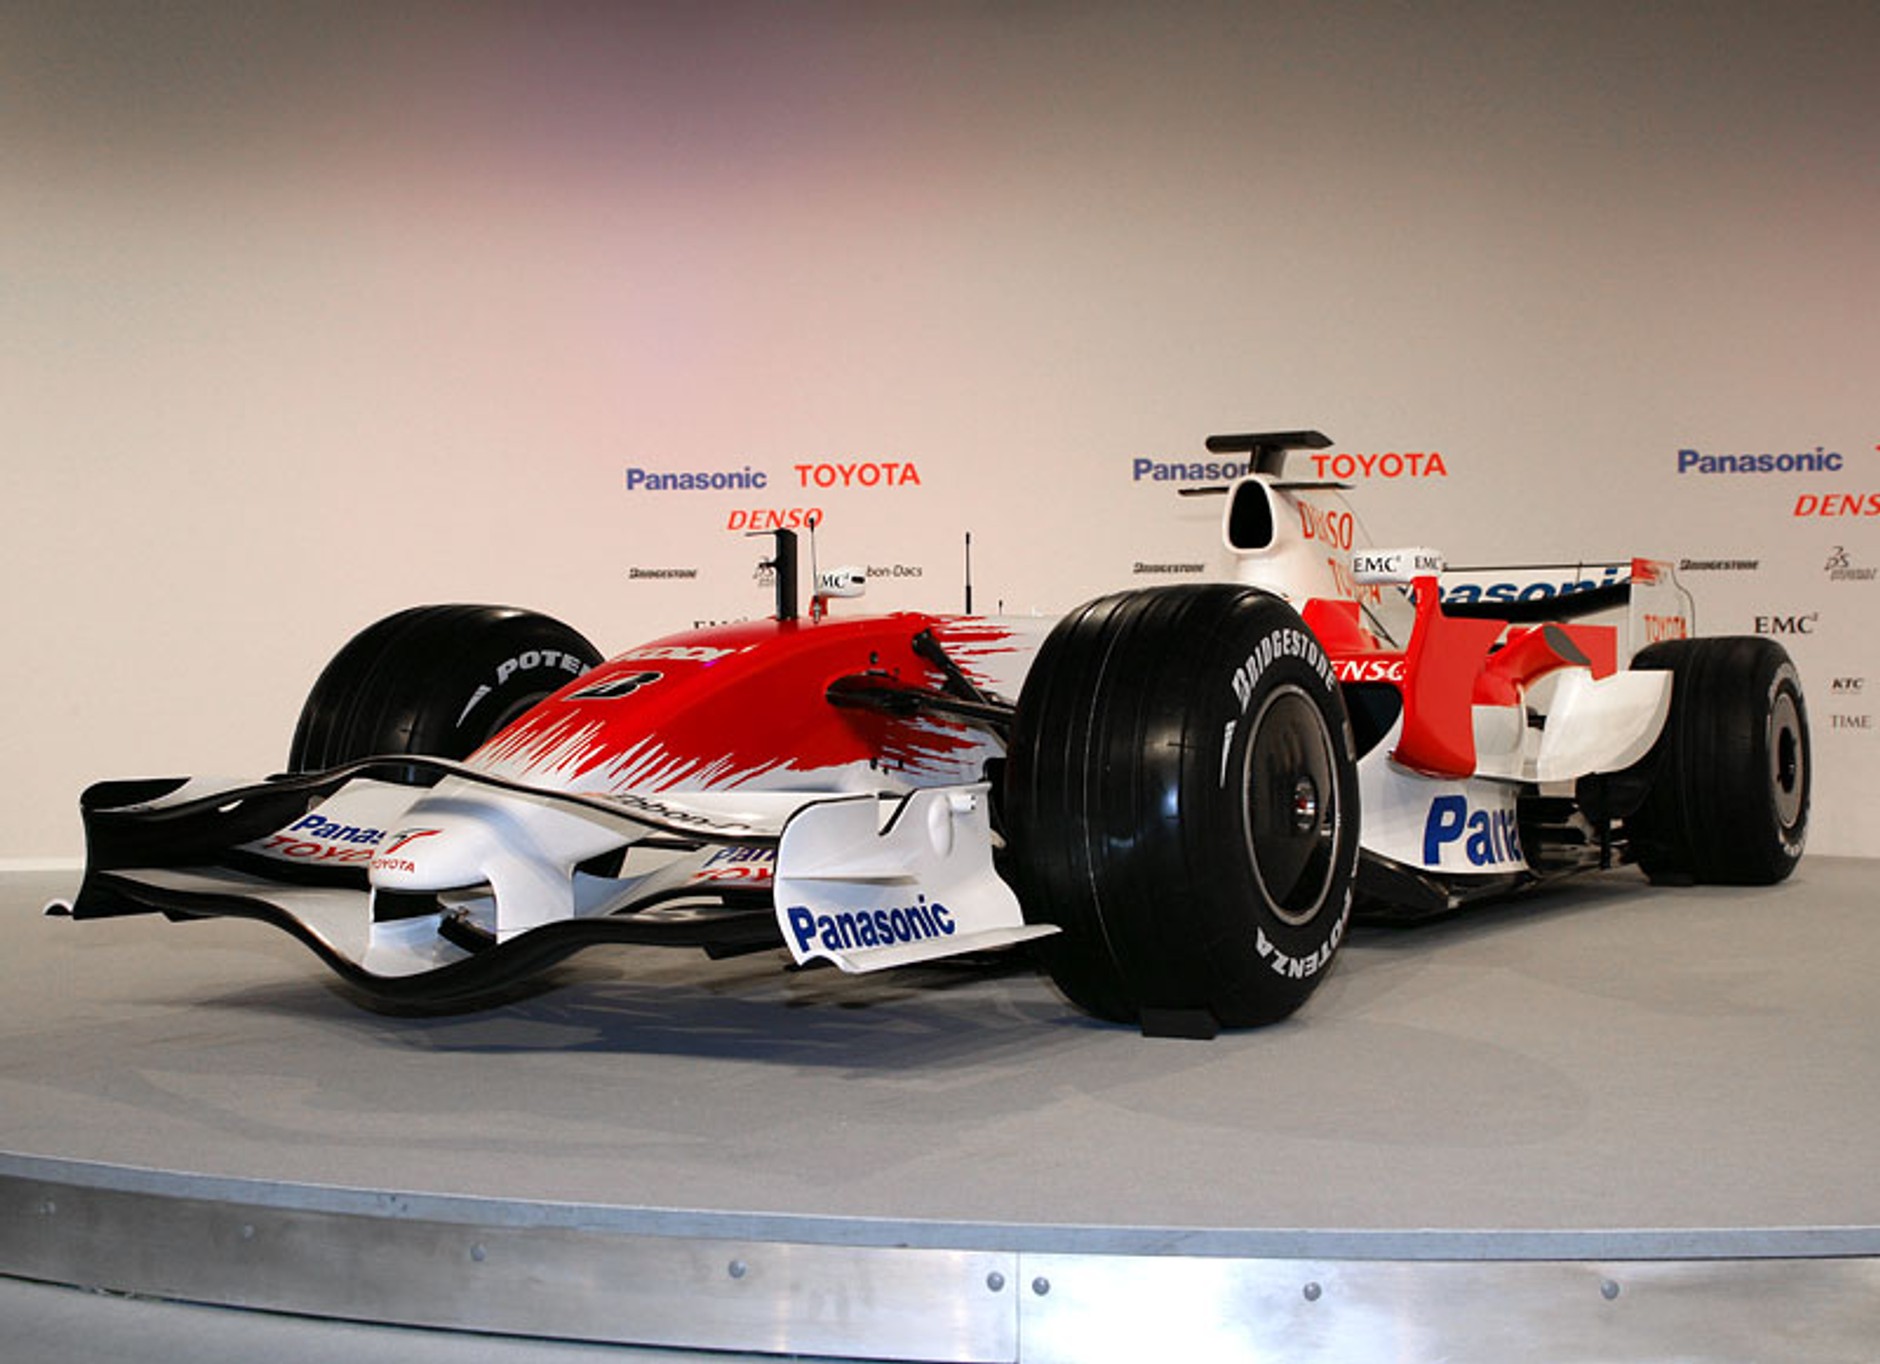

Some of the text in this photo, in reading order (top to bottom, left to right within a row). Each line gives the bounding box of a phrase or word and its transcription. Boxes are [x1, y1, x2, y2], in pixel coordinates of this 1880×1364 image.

[1133, 459, 1252, 481] Panason
[1311, 453, 1448, 478] TOYOTA
[1677, 447, 1843, 474] Panasonic
[626, 467, 768, 491] Panasonic
[795, 463, 921, 487] TOYOTA
[1793, 493, 1880, 517] DENS
[727, 508, 824, 531] DENSO
[866, 564, 923, 578] bon-Dacs
[1232, 628, 1337, 715] BRIDGESTONE
[1330, 660, 1405, 681] ENSO
[1832, 677, 1865, 691] KTC
[1831, 714, 1871, 729] TIME
[263, 834, 376, 862] TOYO
[787, 894, 956, 952] Panasonic
